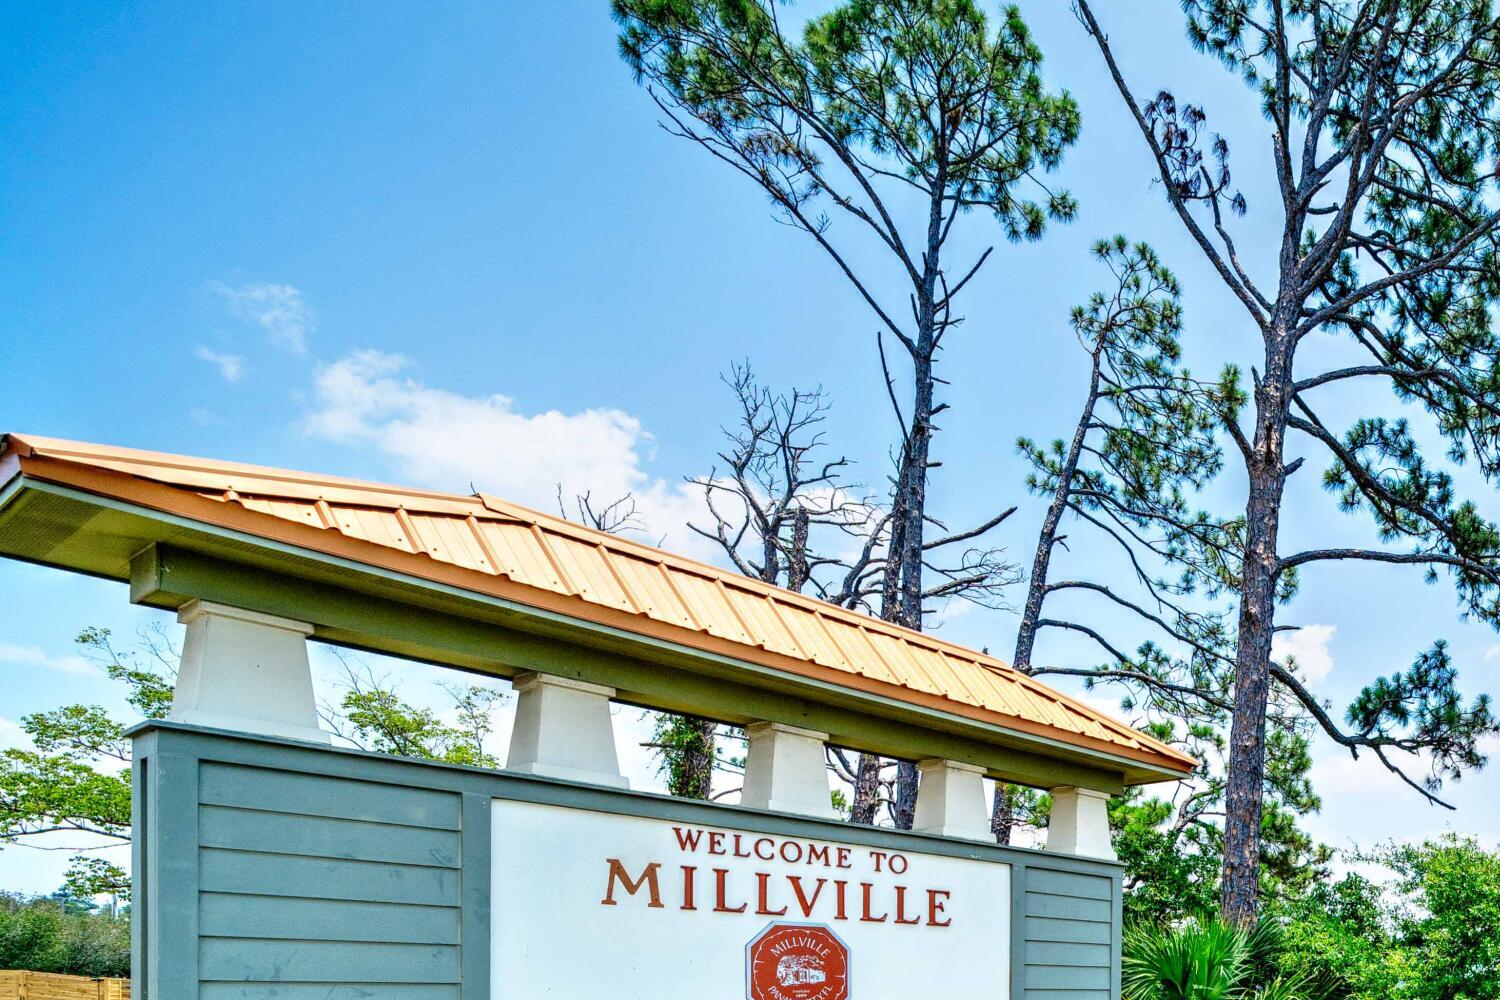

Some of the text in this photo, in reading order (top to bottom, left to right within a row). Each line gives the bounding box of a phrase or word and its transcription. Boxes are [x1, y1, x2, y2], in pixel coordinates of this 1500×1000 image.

[672, 826, 909, 875] WELCOME TO
[601, 858, 952, 928] MILLVILLE
[770, 936, 831, 958] MILLVILLE
[820, 984, 834, 996] FL
